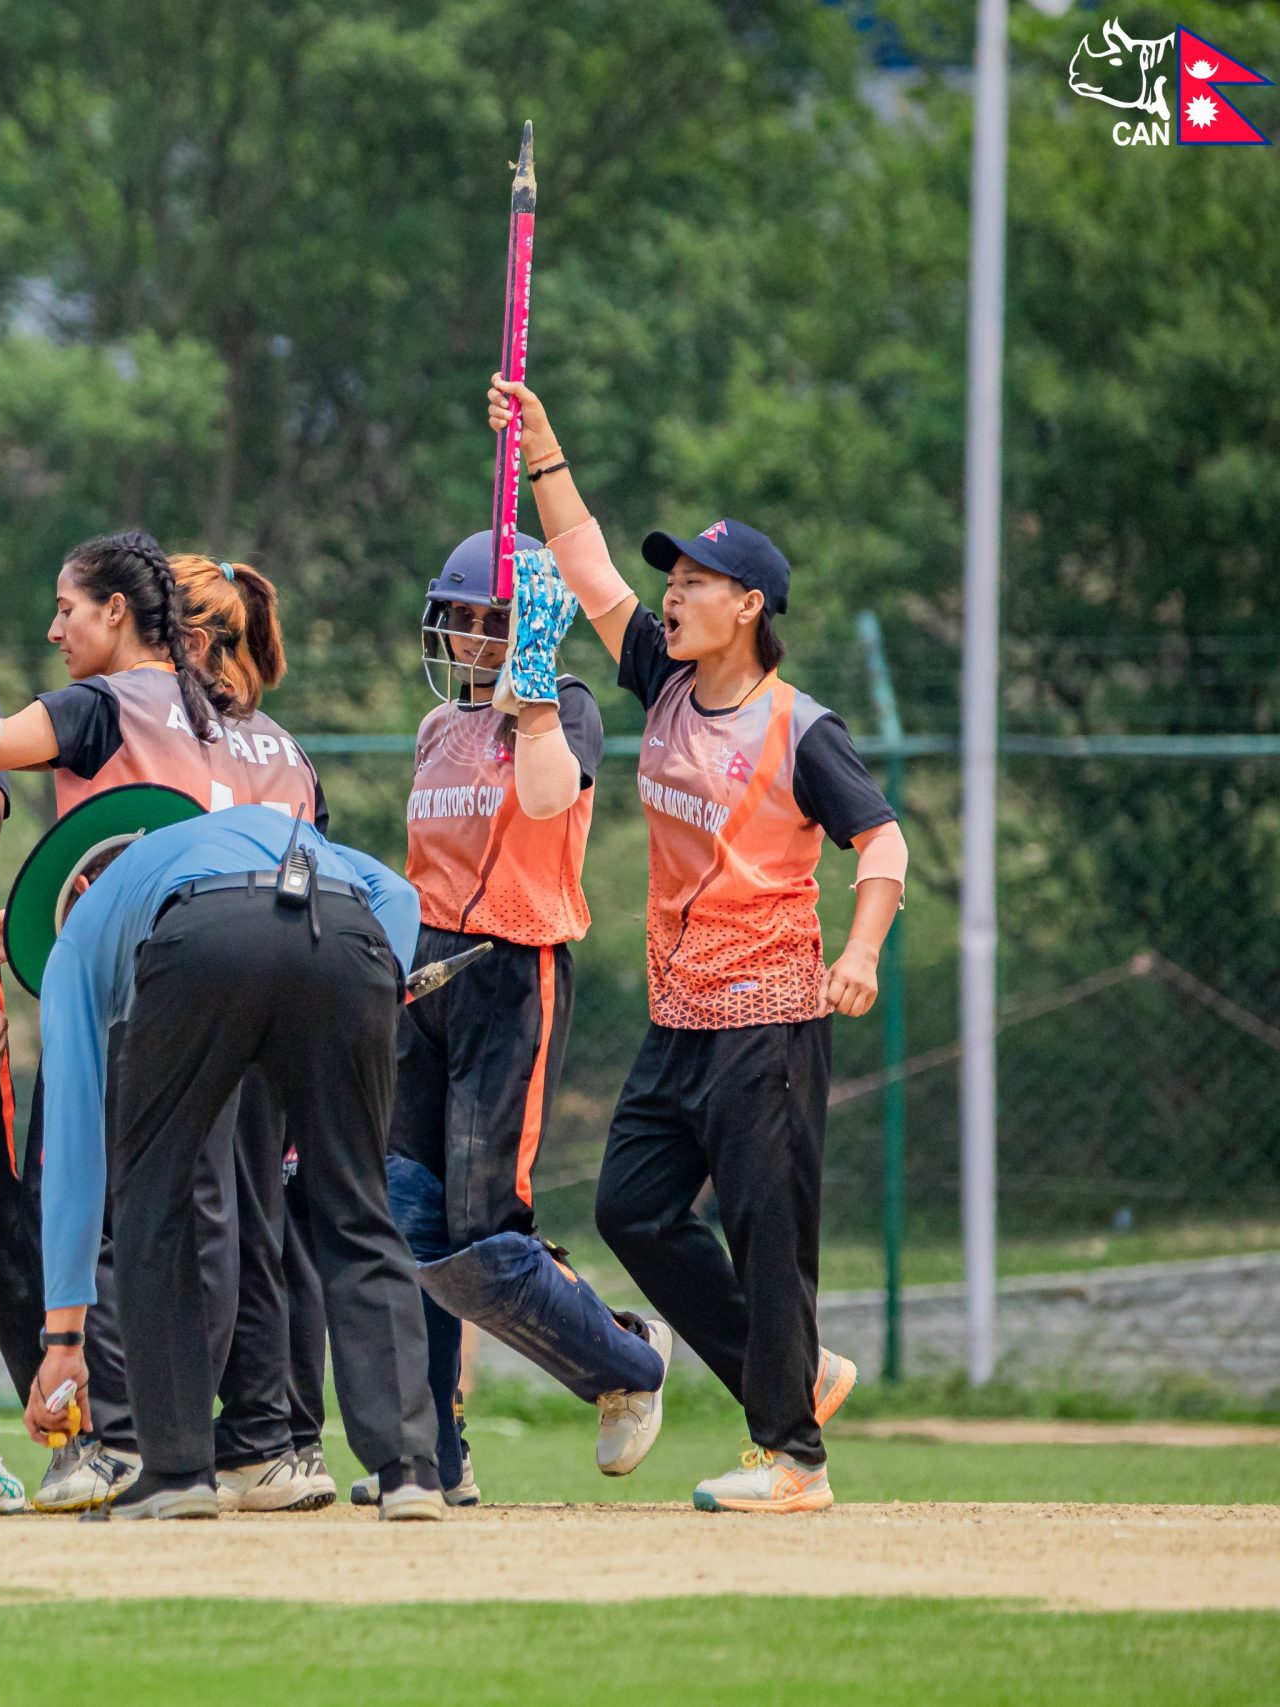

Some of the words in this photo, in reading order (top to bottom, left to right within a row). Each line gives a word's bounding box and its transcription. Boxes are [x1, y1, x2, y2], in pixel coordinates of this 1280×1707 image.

[433, 785, 475, 818] MAYOR'S
[477, 785, 504, 816] CUP
[664, 786, 703, 828] MAYOR'S
[704, 801, 730, 834] CUP
